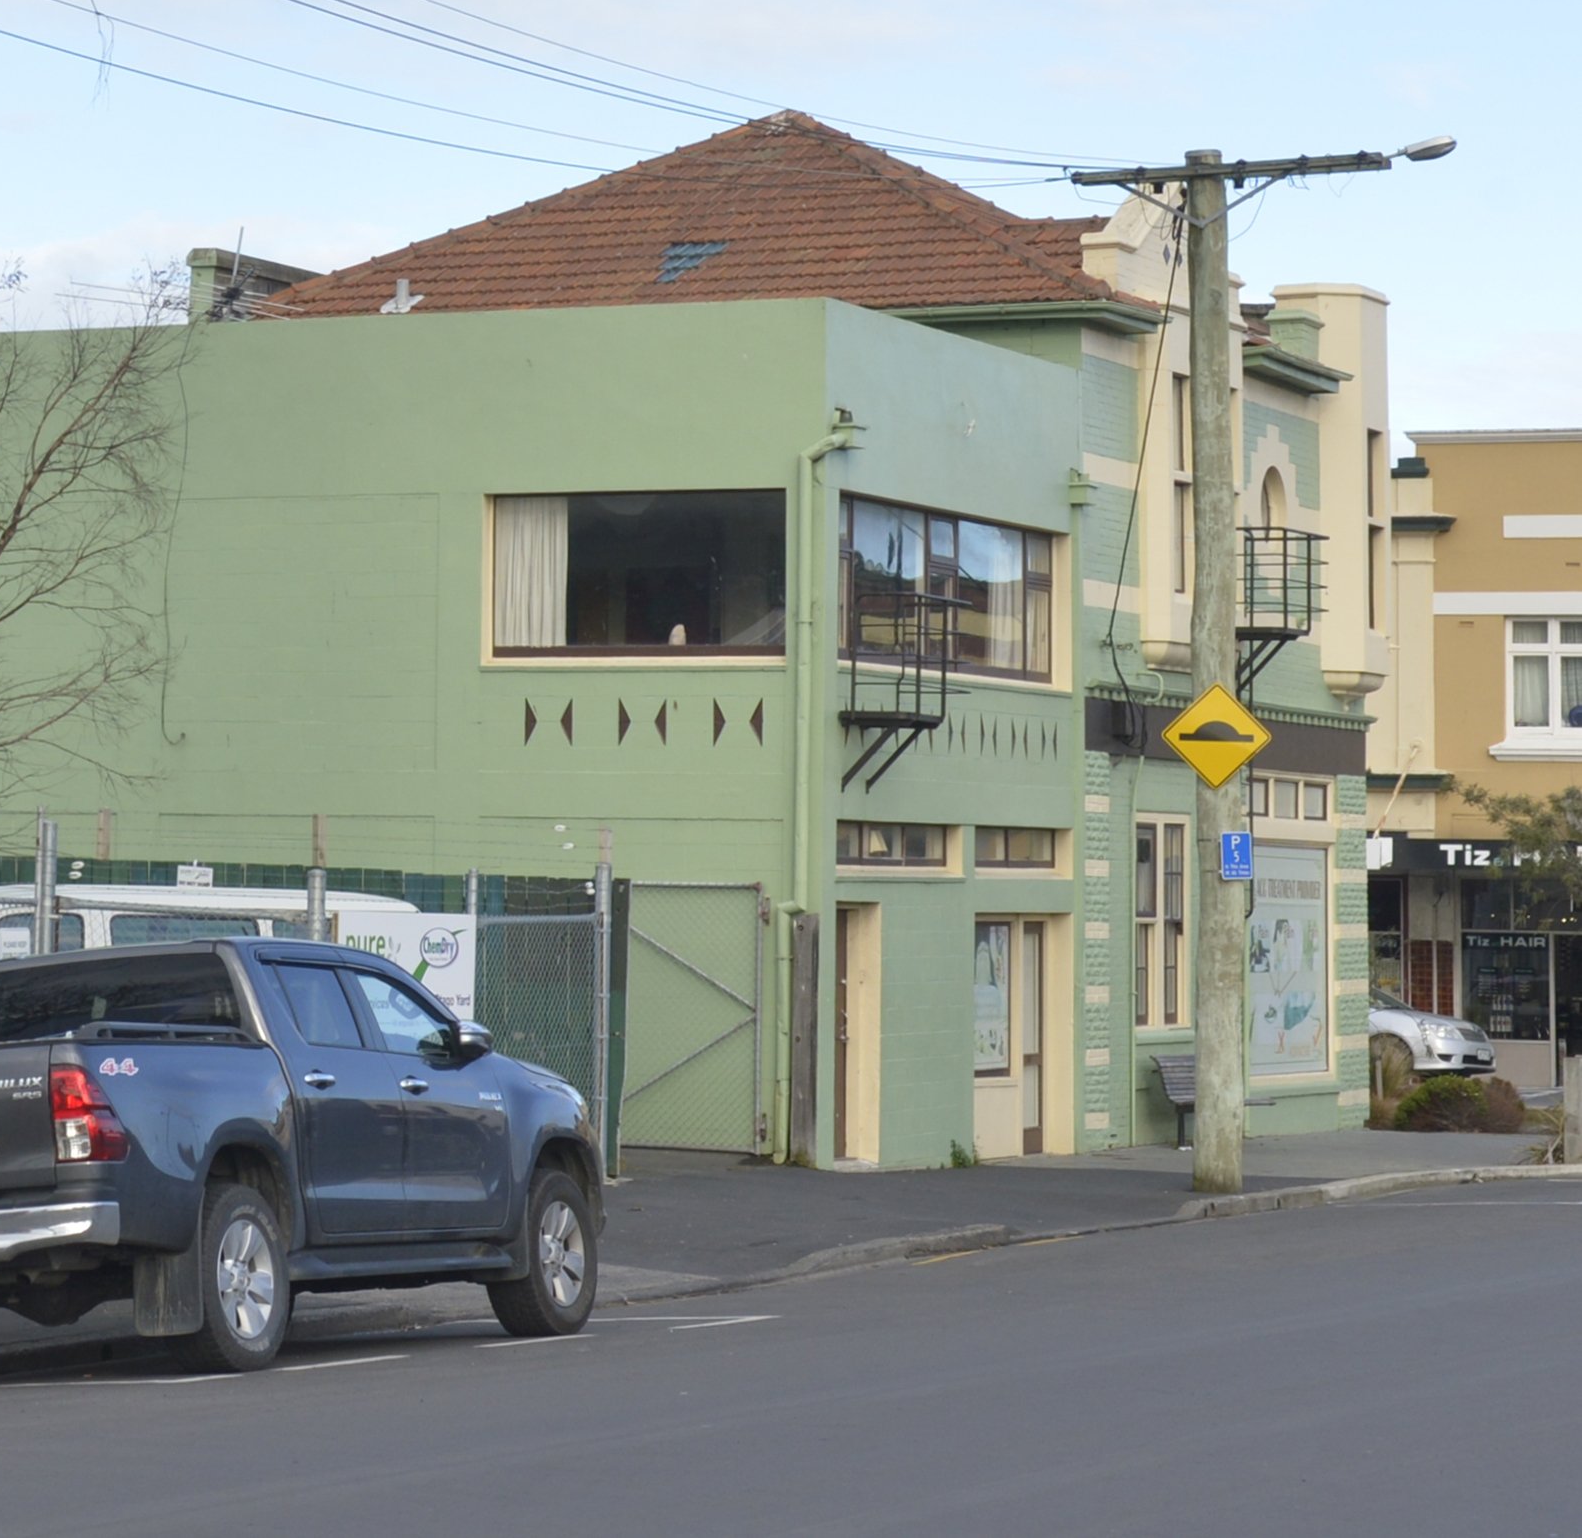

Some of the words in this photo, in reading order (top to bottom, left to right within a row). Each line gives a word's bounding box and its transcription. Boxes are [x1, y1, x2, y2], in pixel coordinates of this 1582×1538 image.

[1231, 835, 1241, 850] P
[1233, 850, 1240, 863] 5
[1439, 844, 1490, 866] Tiz
[1466, 935, 1490, 947] Tiz
[1500, 936, 1546, 948] HAIR
